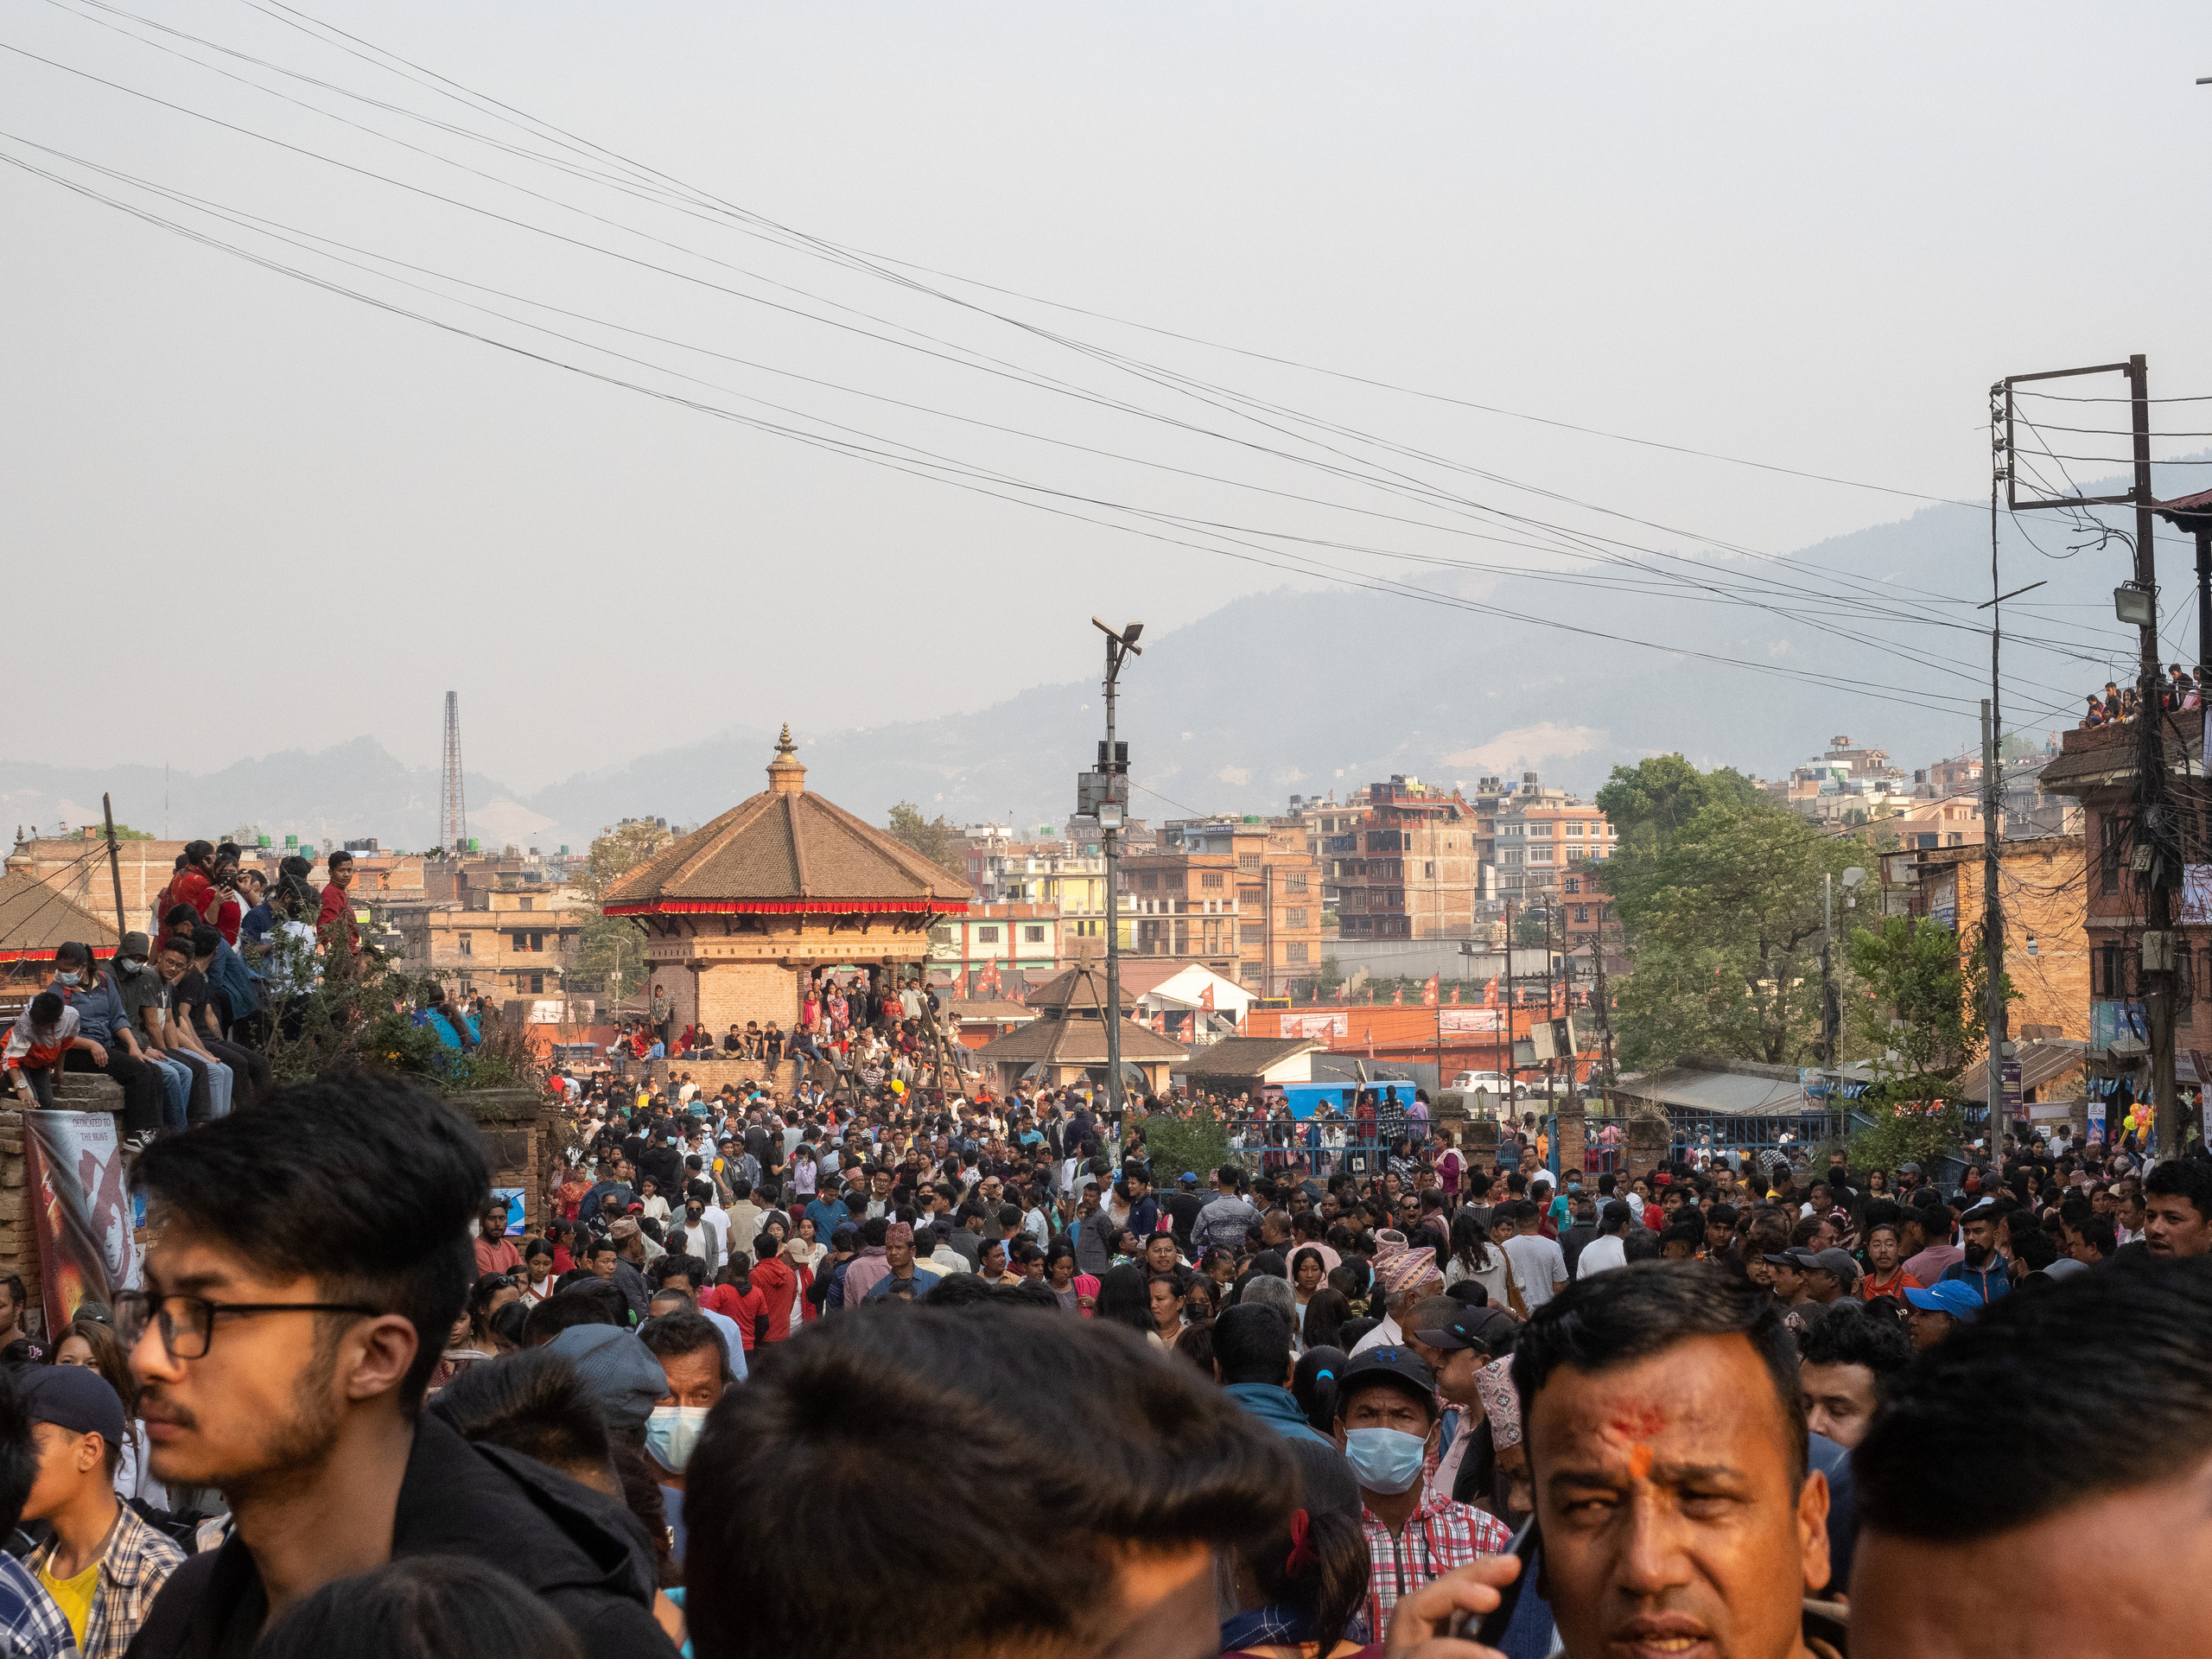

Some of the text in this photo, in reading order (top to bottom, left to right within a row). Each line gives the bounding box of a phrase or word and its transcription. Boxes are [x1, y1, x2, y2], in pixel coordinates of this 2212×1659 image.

[73, 1118, 111, 1128] DEDICATED TO
[80, 1133, 108, 1141] THE BRAVE
